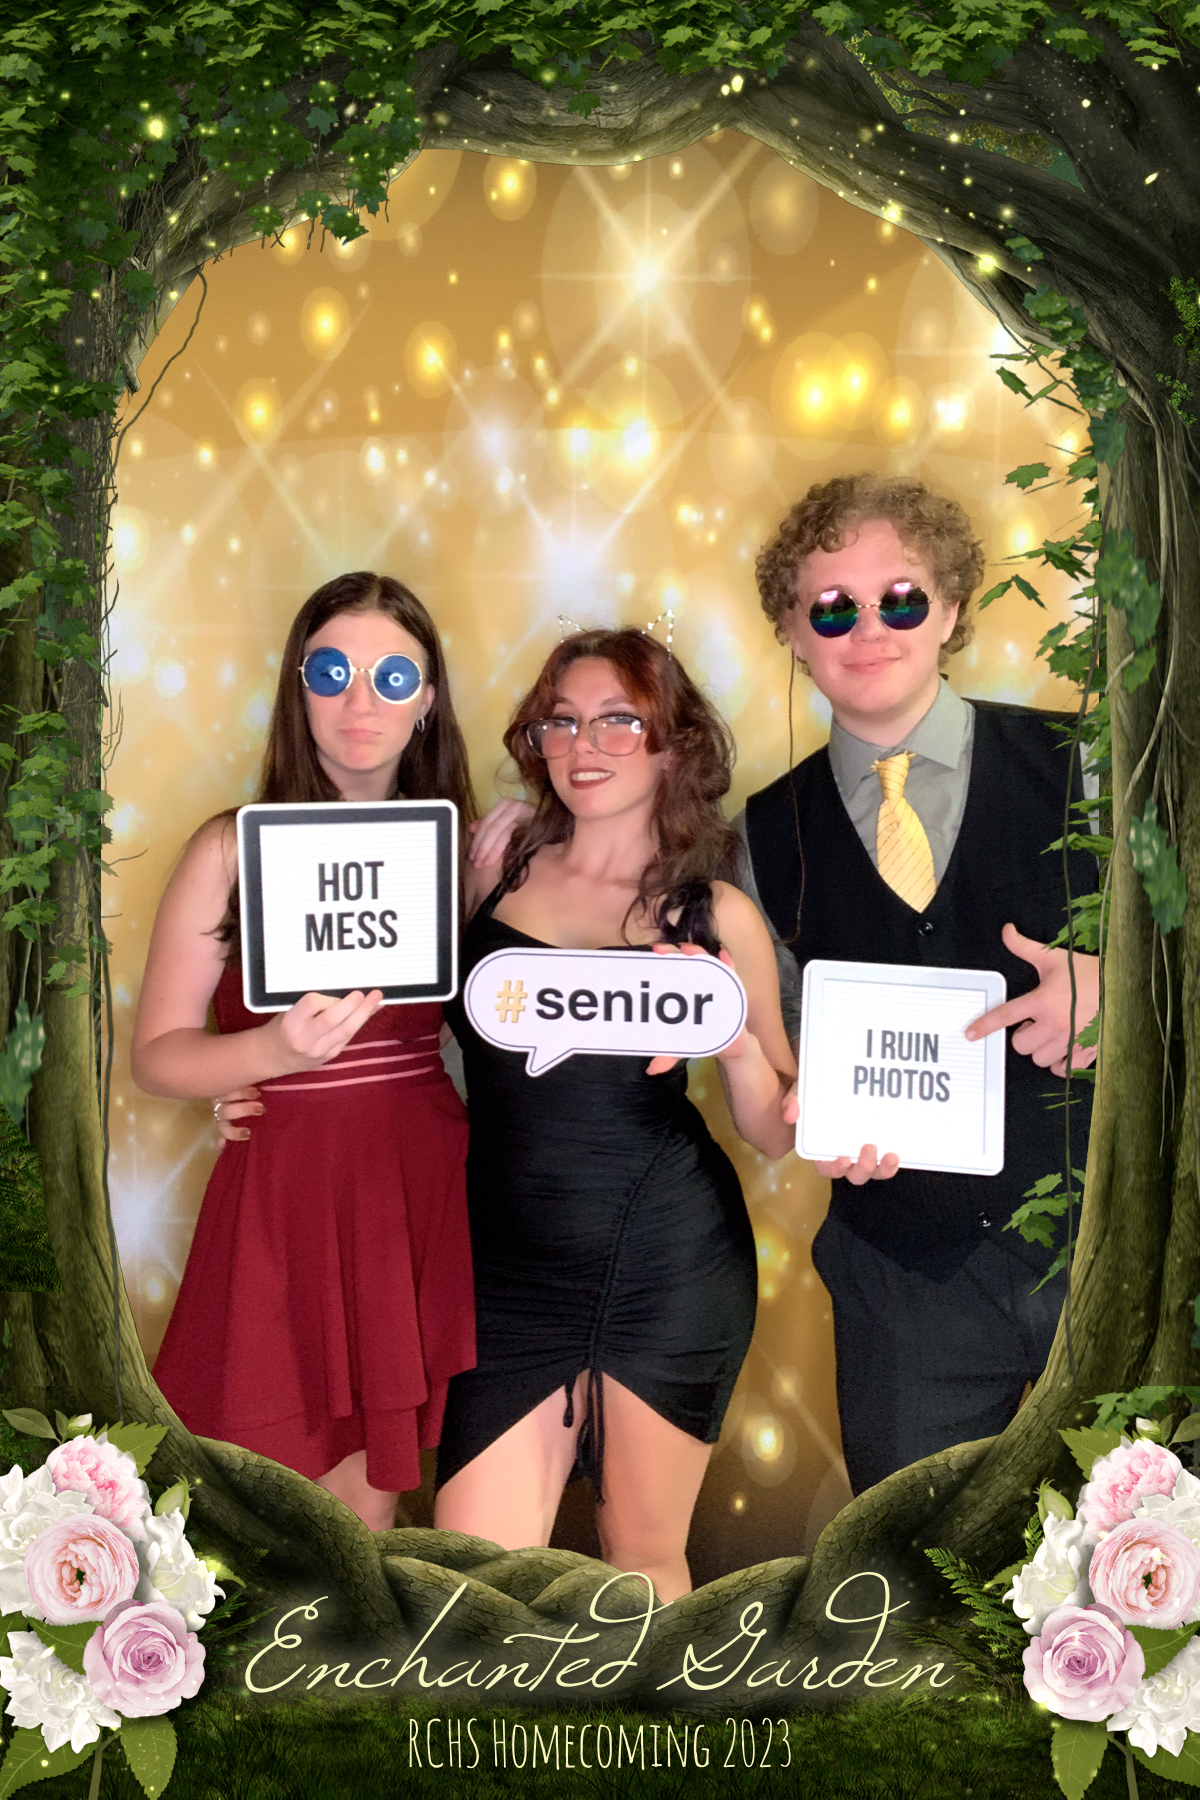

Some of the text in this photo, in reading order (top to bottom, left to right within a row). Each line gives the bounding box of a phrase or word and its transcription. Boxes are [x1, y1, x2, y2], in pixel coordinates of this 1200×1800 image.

[318, 861, 384, 902] HOT
[306, 910, 398, 952] MESS
[494, 979, 714, 1025] #senior
[866, 1029, 939, 1063] I RUIN
[852, 1065, 951, 1103] PHOTOS
